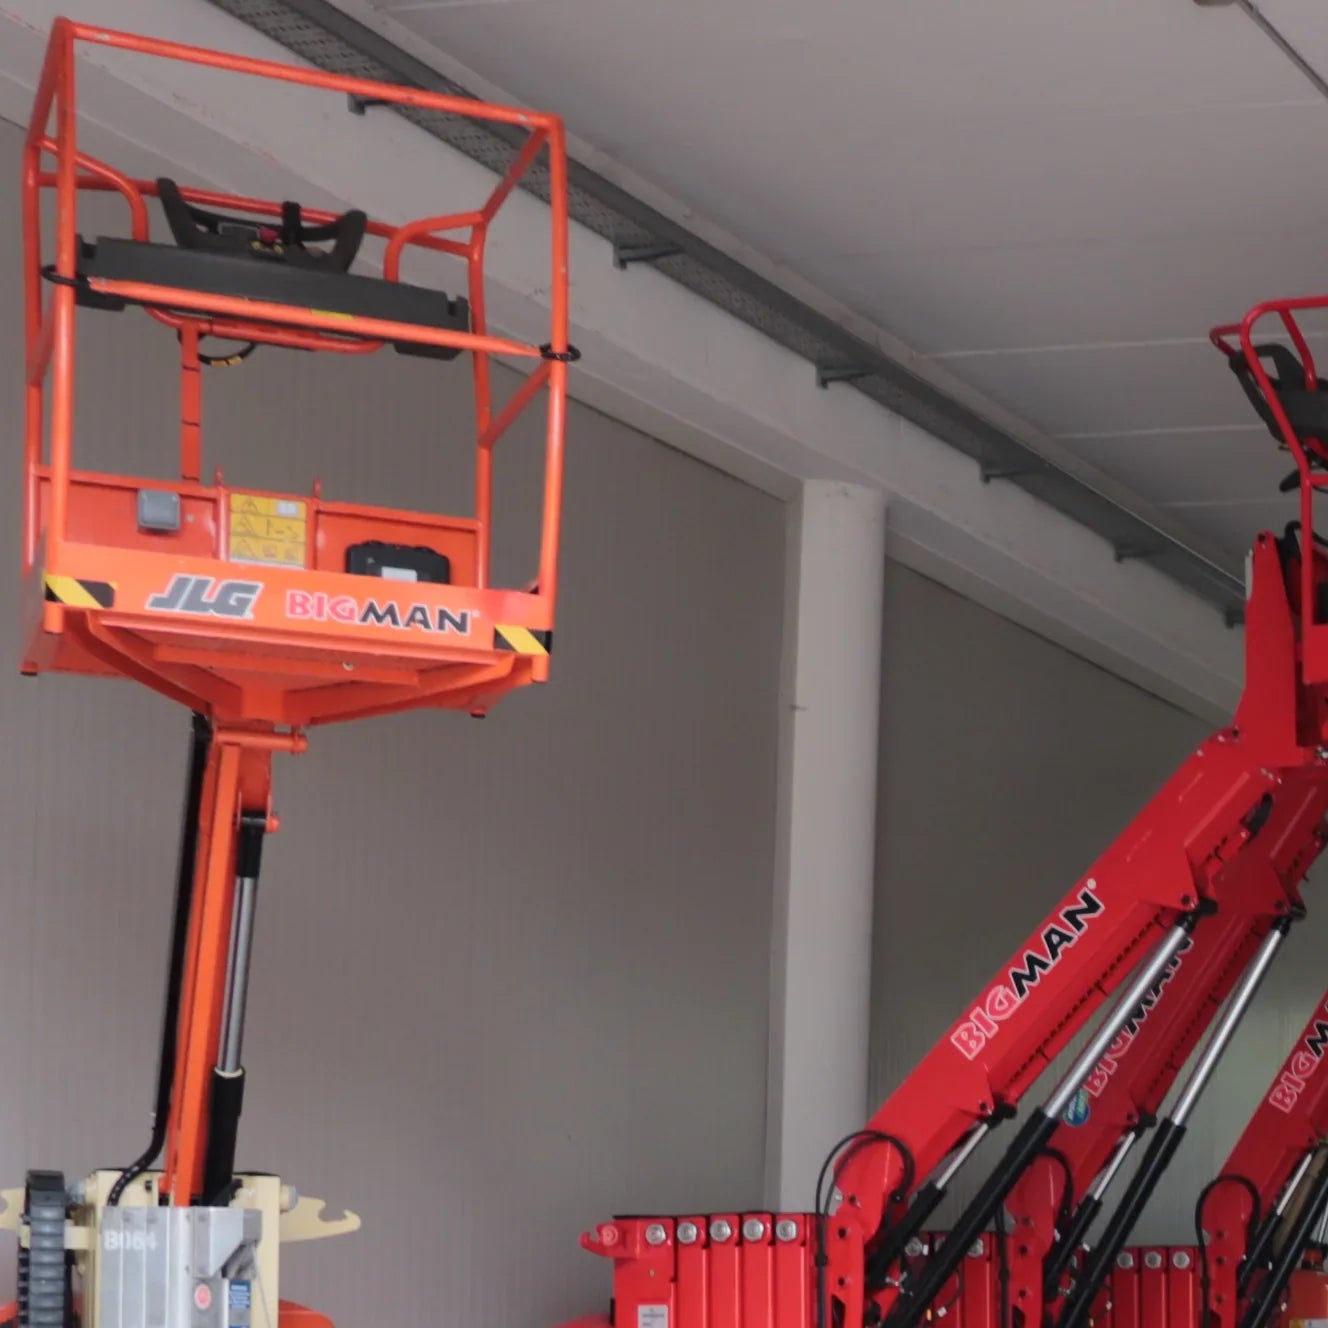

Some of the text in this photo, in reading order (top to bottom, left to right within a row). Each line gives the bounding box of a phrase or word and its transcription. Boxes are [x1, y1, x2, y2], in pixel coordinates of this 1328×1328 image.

[146, 573, 472, 636] JLG BIGMAN
[951, 888, 1105, 1060] BIGMAN
